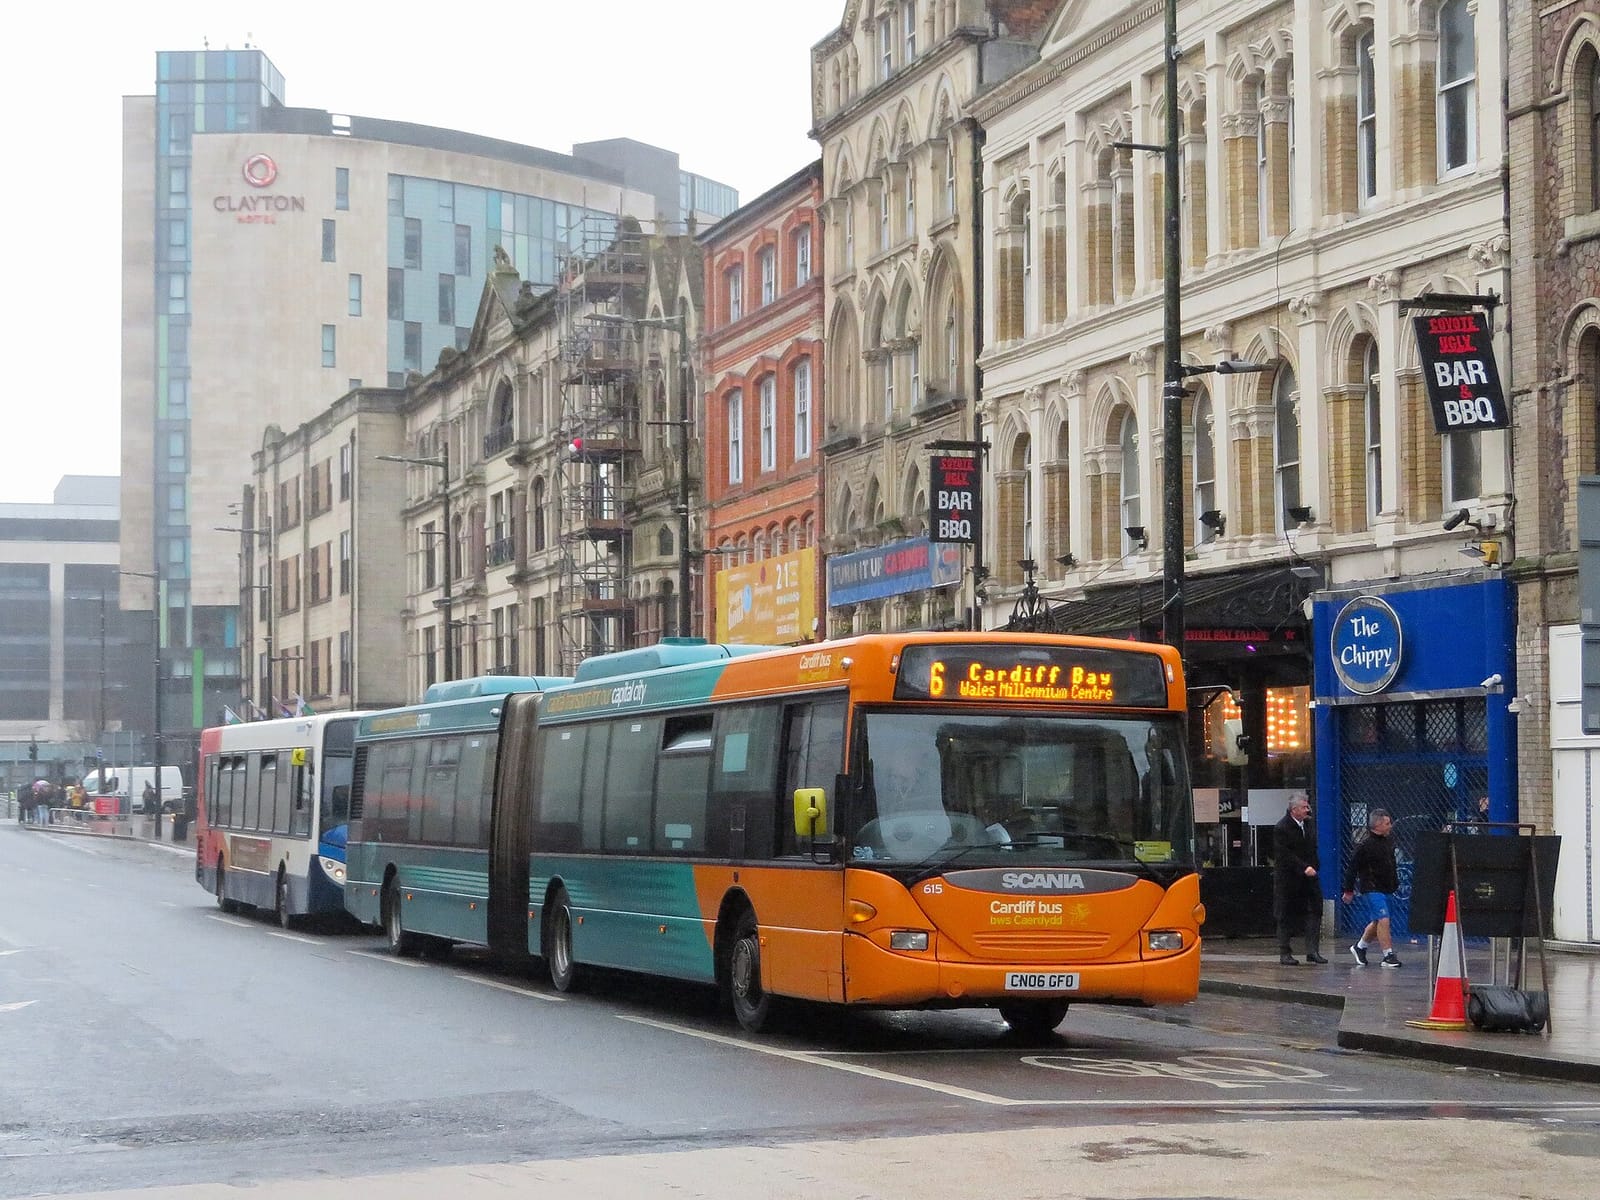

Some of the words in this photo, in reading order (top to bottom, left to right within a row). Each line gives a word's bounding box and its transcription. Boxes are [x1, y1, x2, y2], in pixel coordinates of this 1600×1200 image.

[213, 195, 305, 212] CLAYTON
[1428, 316, 1479, 334] COYOTE
[1438, 334, 1477, 354] UGLY
[1433, 359, 1488, 387] BAR
[1459, 384, 1473, 400] &
[1443, 396, 1496, 426] BBQ
[938, 490, 972, 511] BAR
[938, 519, 972, 540] BBQ
[832, 560, 859, 586] TURN
[1350, 615, 1380, 637] The
[1340, 643, 1392, 670] Chippy
[929, 661, 946, 697] 6
[968, 662, 1062, 684] Cardiff
[1070, 666, 1113, 686] Bay
[611, 681, 635, 708] capital
[633, 680, 648, 705] city
[959, 680, 997, 698] Wales
[999, 682, 1068, 700] Millennium
[1070, 684, 1114, 701] Centre
[923, 884, 943, 894] 615
[1002, 873, 1084, 889] SCANIA
[990, 900, 1034, 914] Cardiff
[1038, 900, 1062, 914] bus
[990, 915, 1012, 925] bws
[1014, 914, 1063, 927] Caerdydd
[1010, 974, 1045, 988] CN06
[1048, 974, 1074, 988] GFO
